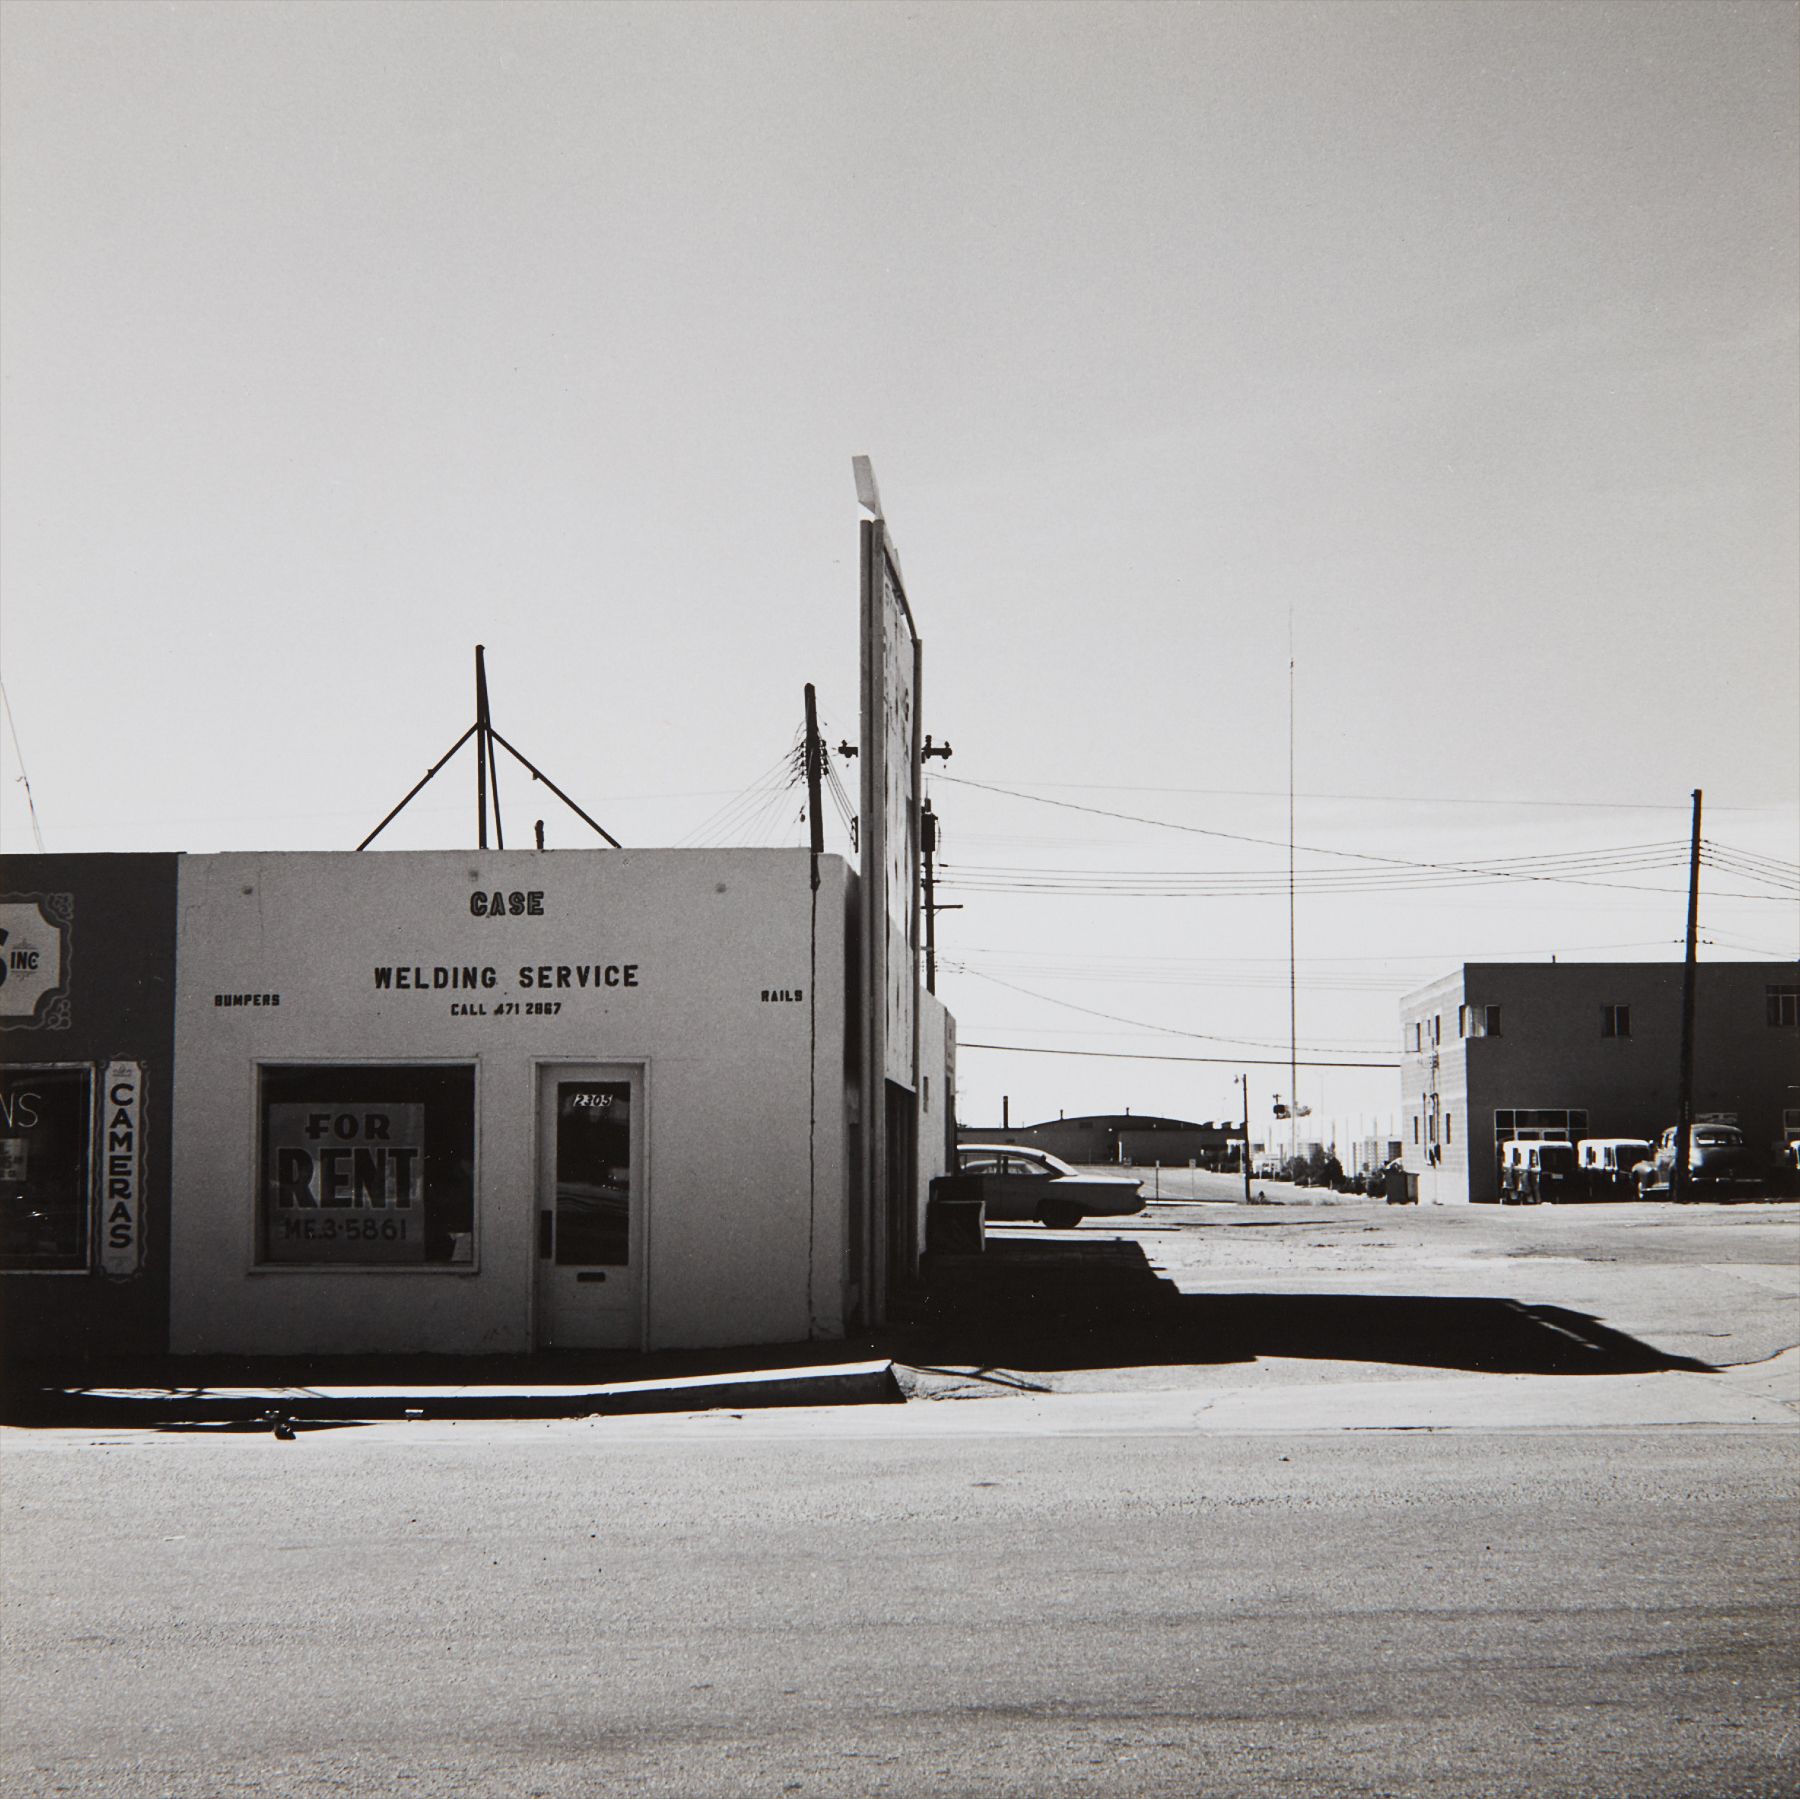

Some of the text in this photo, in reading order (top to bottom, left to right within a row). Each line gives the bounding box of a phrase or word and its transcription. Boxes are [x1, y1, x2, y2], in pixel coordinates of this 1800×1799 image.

[470, 891, 544, 916] CASE
[374, 965, 638, 989] WELDING SERVICE
[215, 994, 280, 1007] BUMPERS
[761, 990, 803, 1003] RAILS
[451, 1003, 487, 1016] CALL
[573, 1094, 613, 1107] 2305
[305, 1114, 390, 1140] FOR
[109, 1083, 133, 1249] CAMERAS
[277, 1147, 420, 1210] RENT
